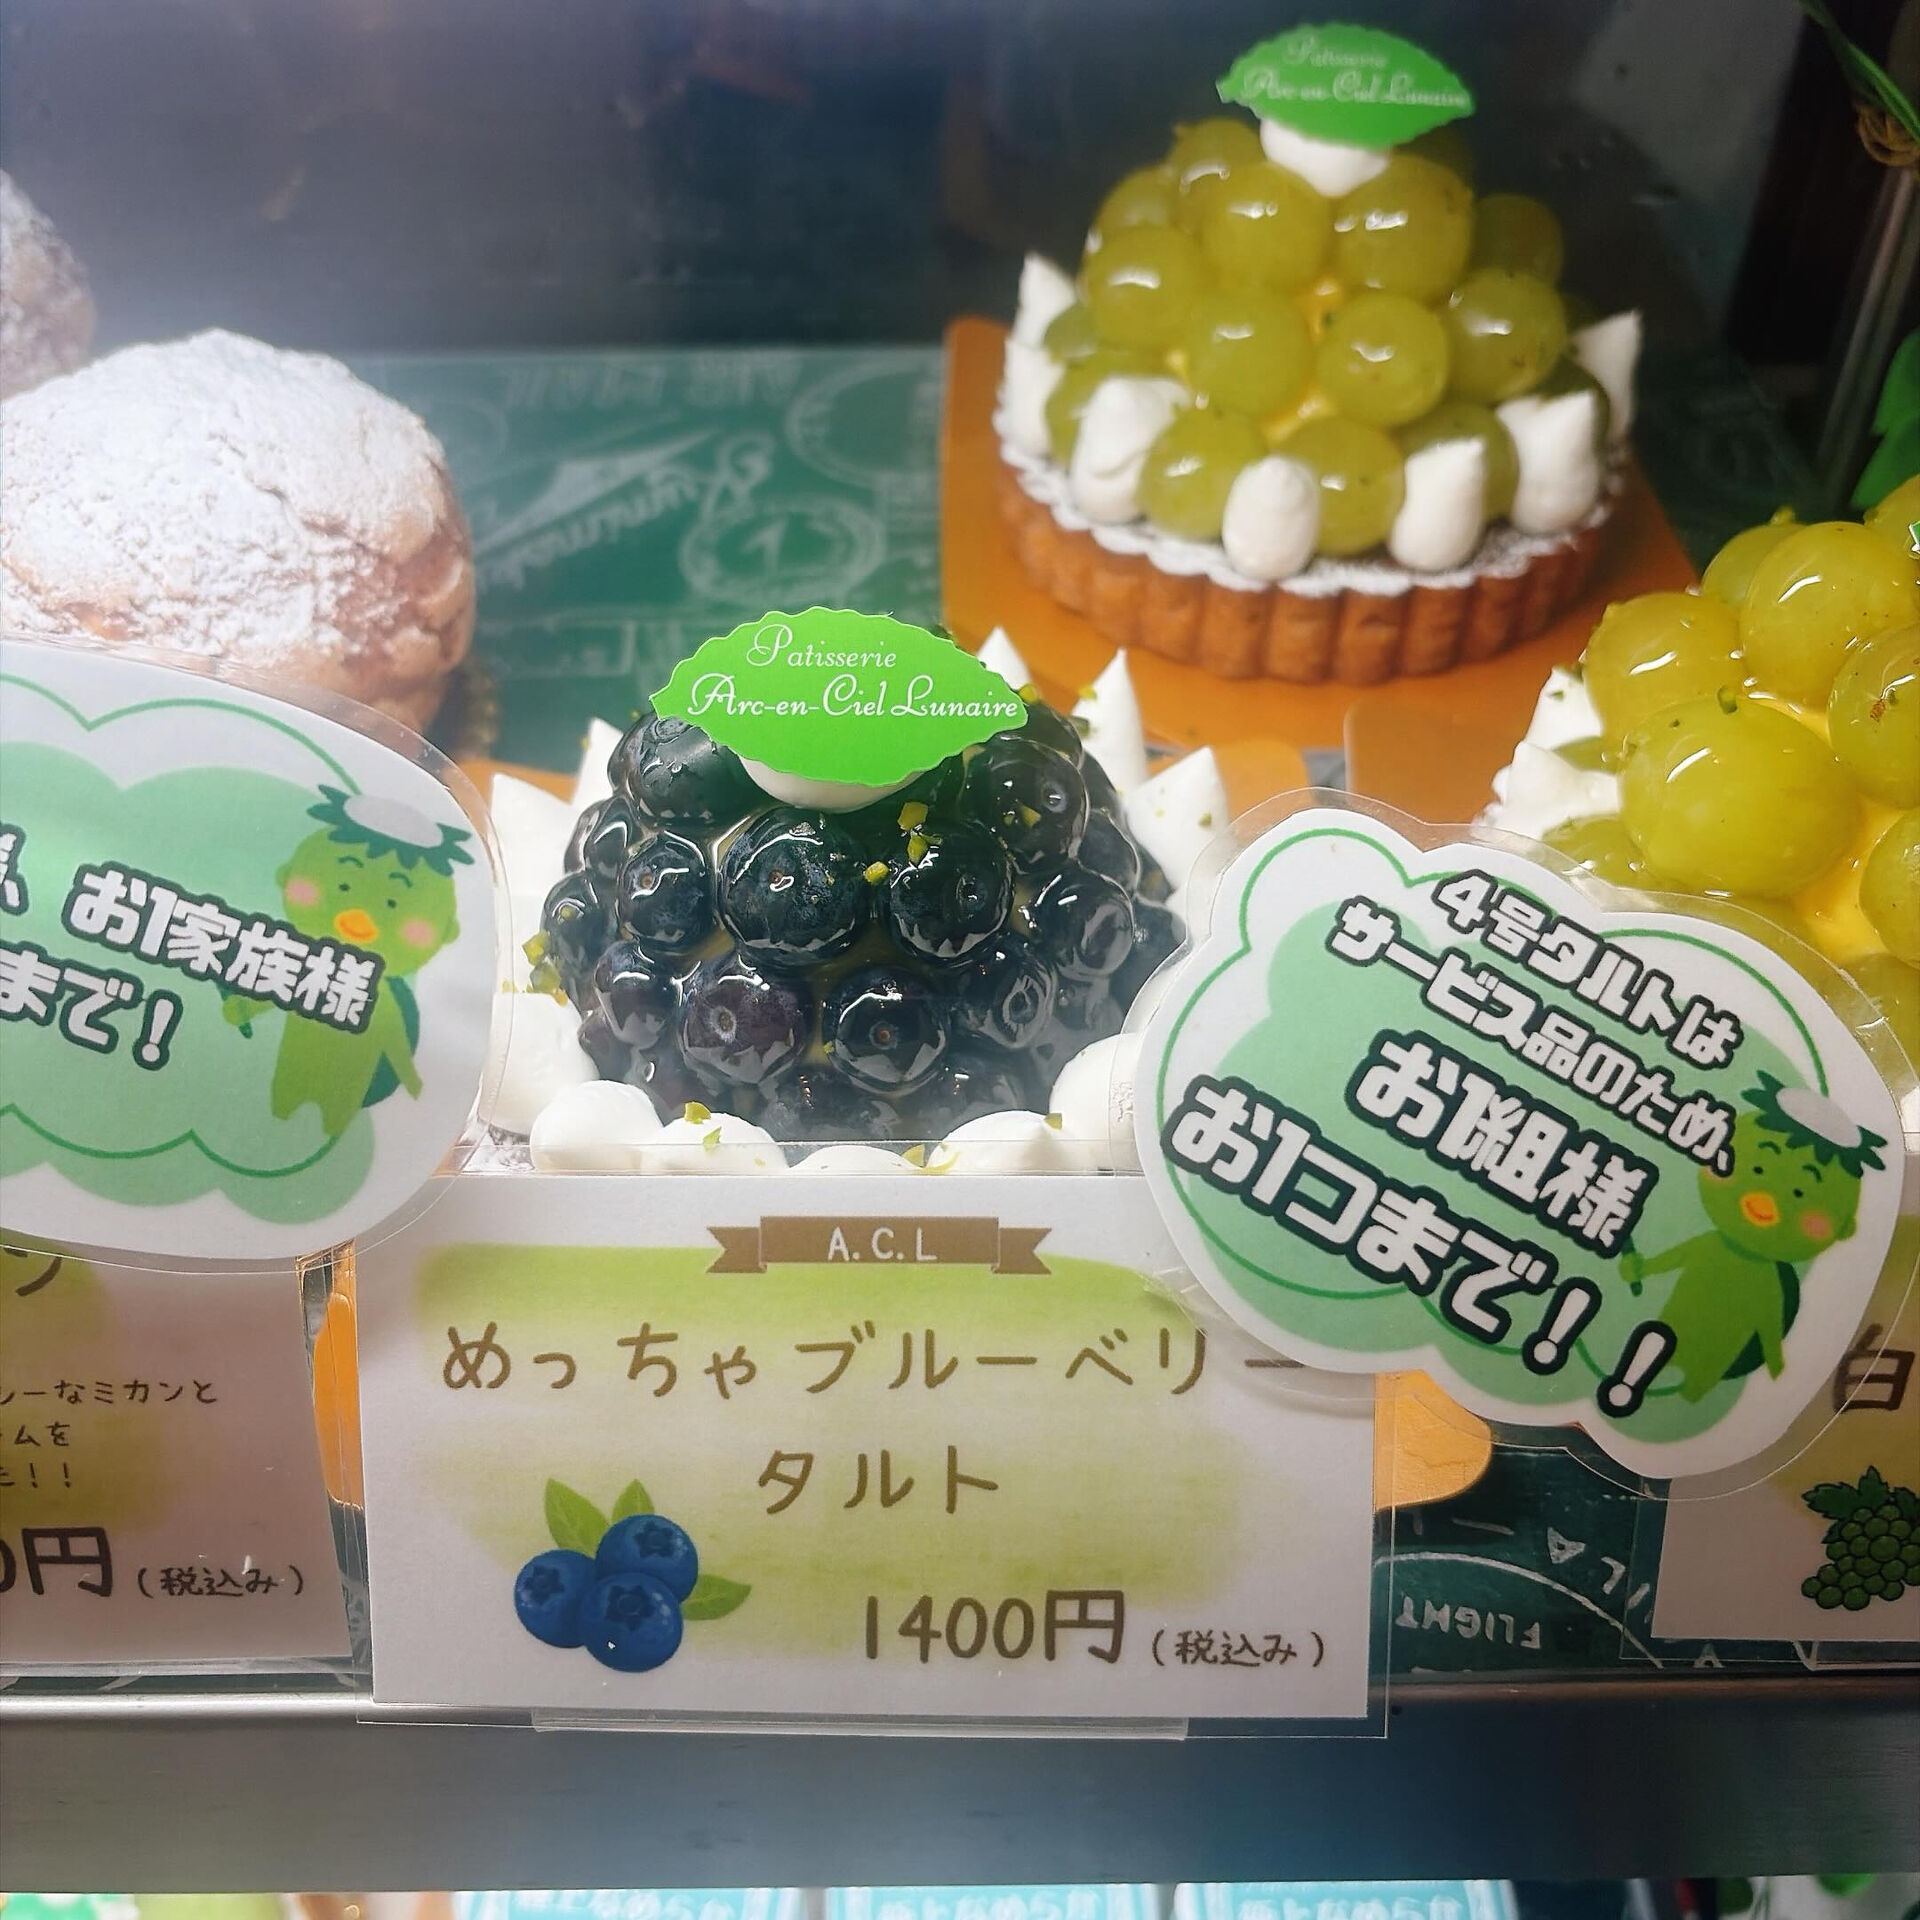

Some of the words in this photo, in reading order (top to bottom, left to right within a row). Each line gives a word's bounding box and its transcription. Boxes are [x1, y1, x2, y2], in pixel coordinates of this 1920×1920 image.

[746, 623, 897, 668] Patisserie
[687, 672, 885, 717] Arc-en-Ciel
[890, 674, 1018, 717] Lunaire
[1434, 871, 1741, 1068] 4号タルトは
[1328, 898, 1733, 1174] サービス品のため、
[1350, 1033, 1656, 1253] お1組様
[442, 1320, 1306, 1400] めっちゃブルーベリー
[1833, 1323, 1915, 1414] 白
[757, 1444, 998, 1515] タルト
[865, 1589, 1125, 1665] 1400円
[1395, 1595, 1541, 1650] FLIGHT
